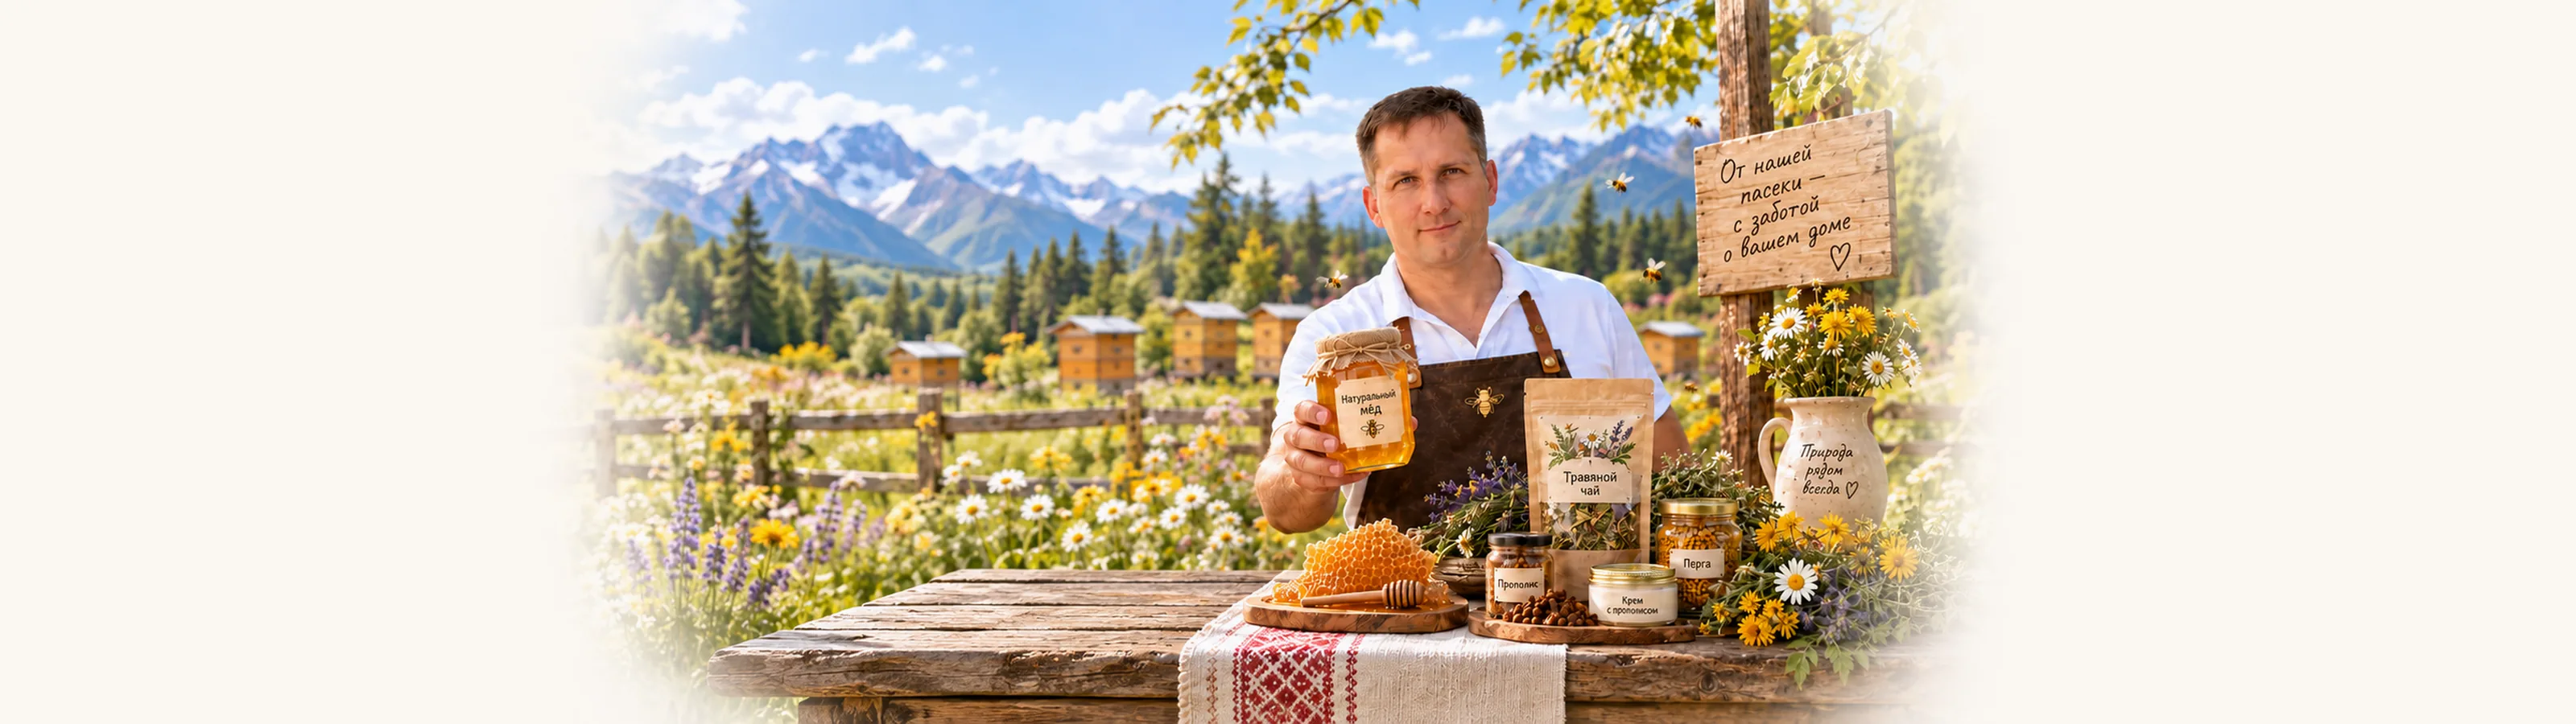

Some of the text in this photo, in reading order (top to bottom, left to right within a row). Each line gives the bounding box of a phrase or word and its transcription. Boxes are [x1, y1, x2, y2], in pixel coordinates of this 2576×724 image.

[1720, 144, 1811, 184] От нашей
[1741, 178, 1802, 204] пасеки
[1733, 195, 1819, 236] с заботой
[1724, 216, 1851, 262] о вашем доме
[1341, 389, 1397, 405] Натуральный
[1801, 443, 1853, 462] Природа
[1563, 471, 1617, 484] Травяной
[1805, 463, 1843, 480] рядом
[1580, 485, 1600, 496] чай
[1684, 558, 1711, 570] Перга
[1622, 596, 1643, 606] Крем
